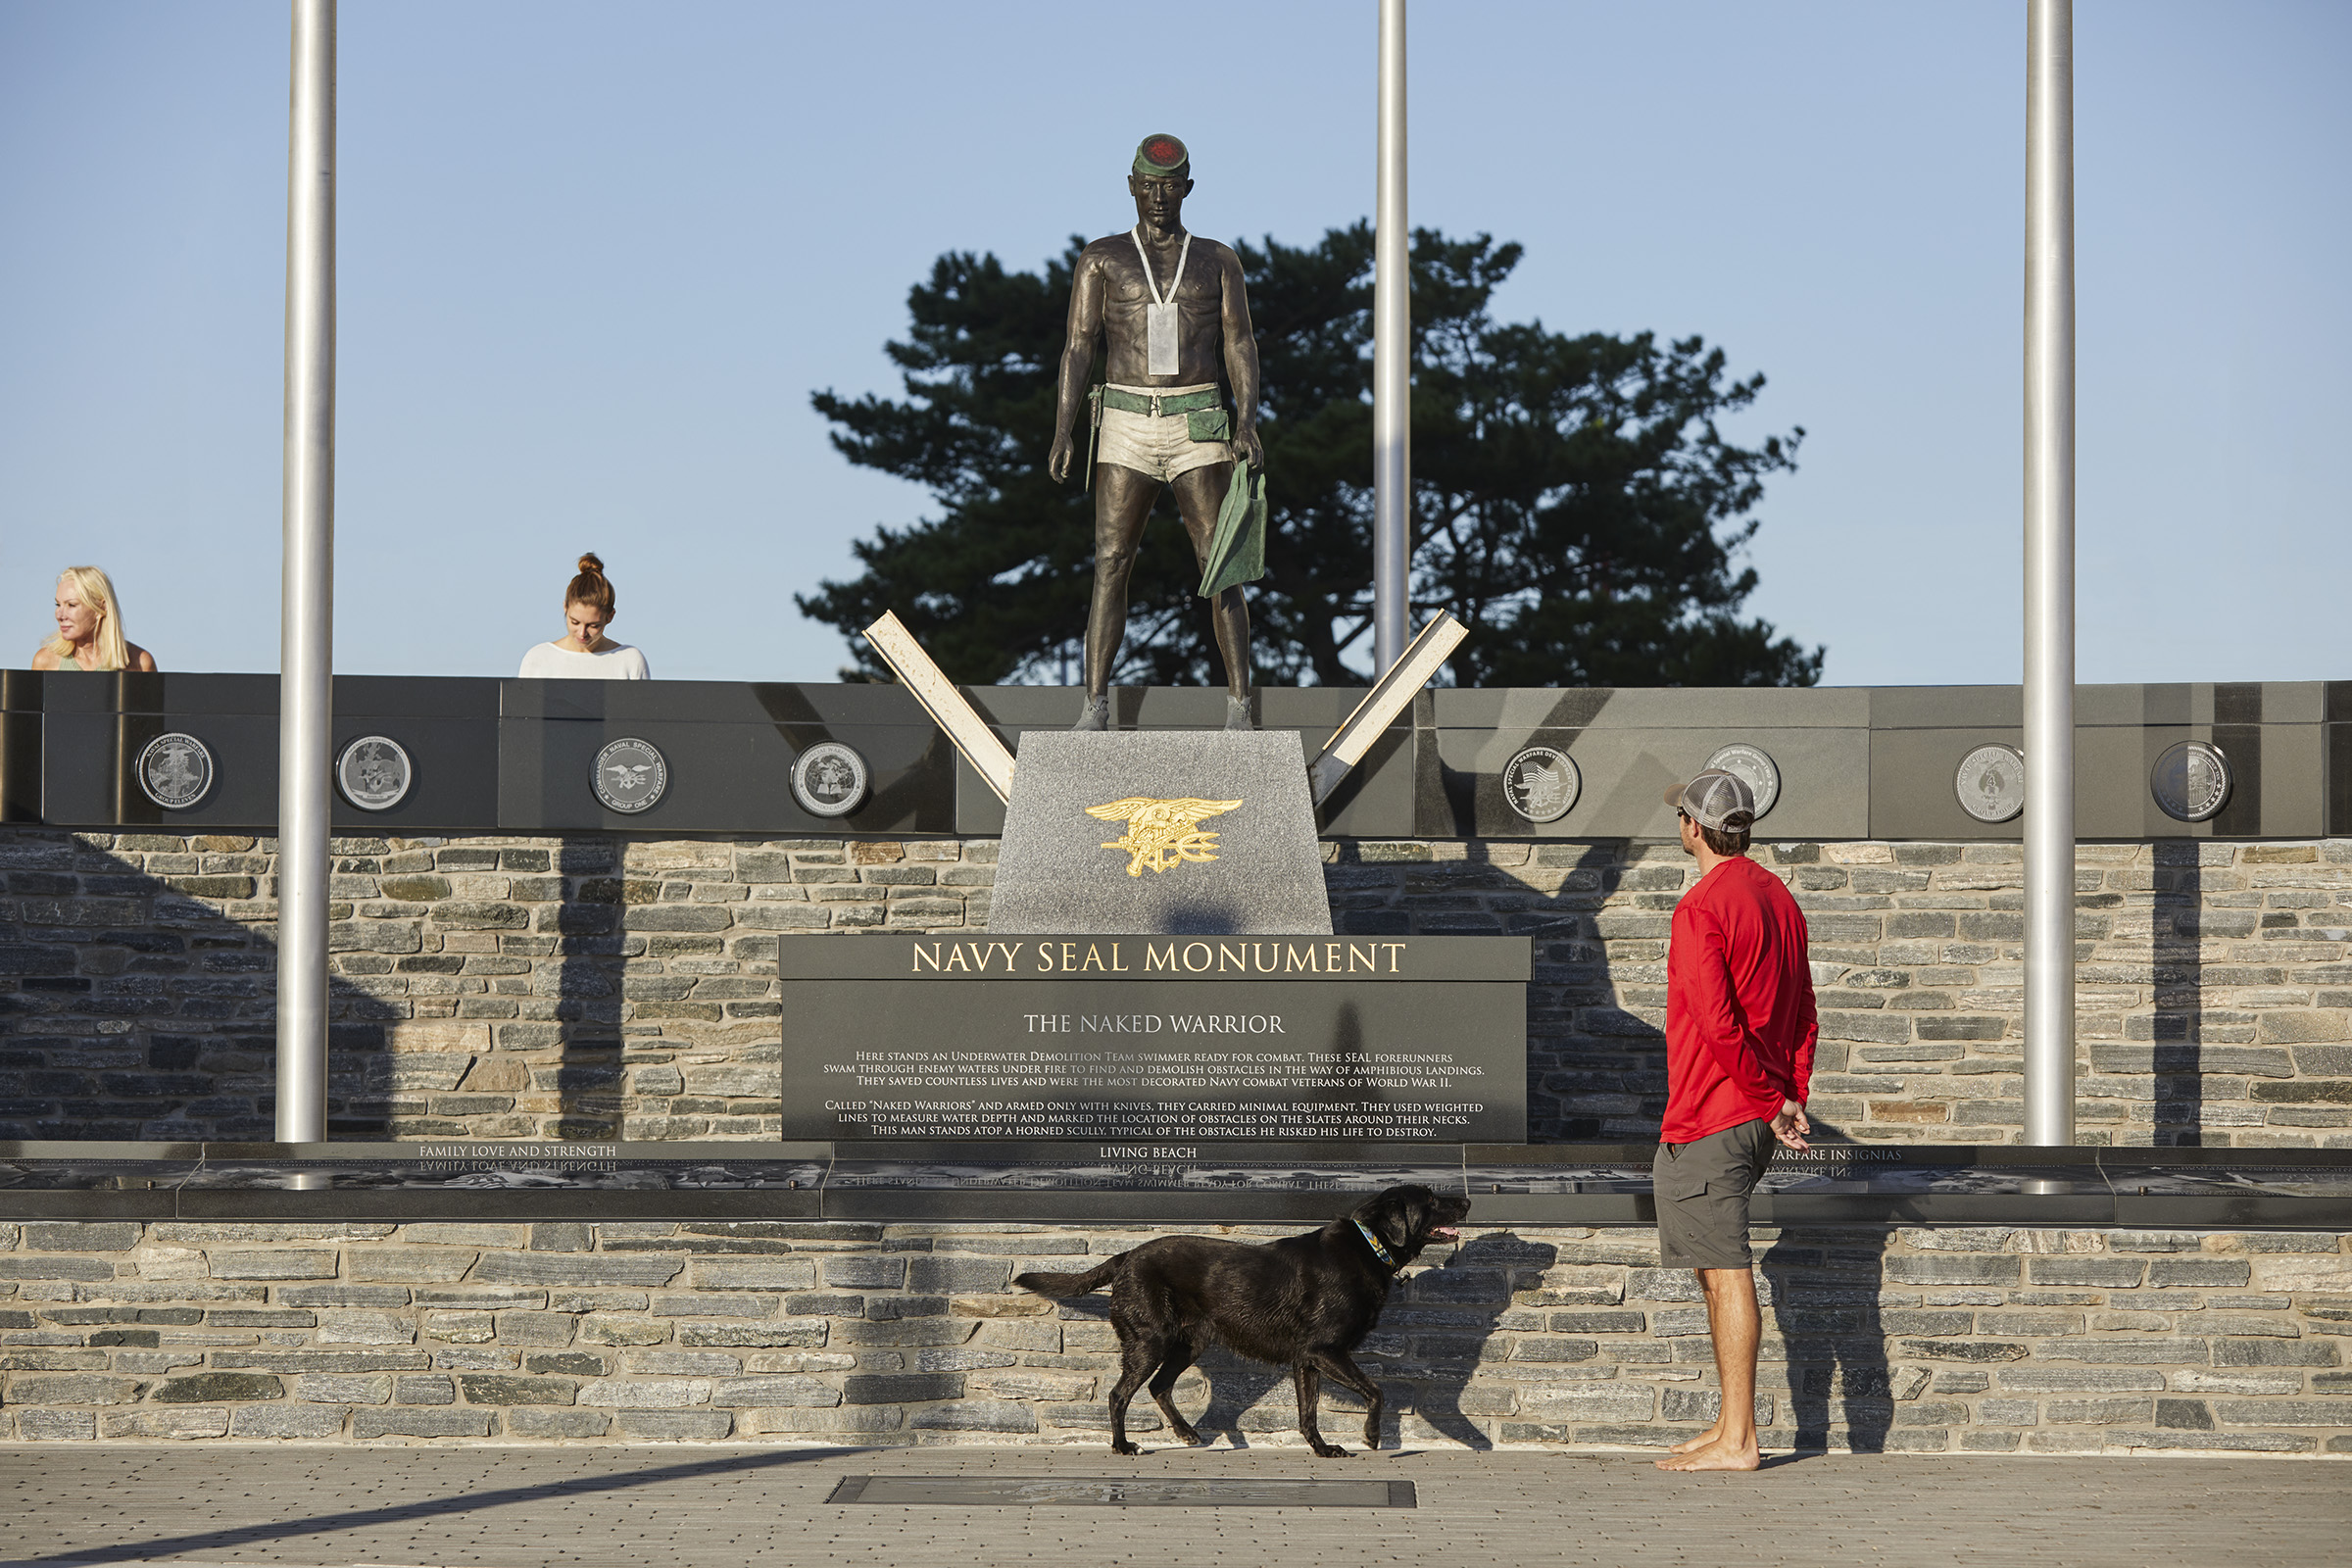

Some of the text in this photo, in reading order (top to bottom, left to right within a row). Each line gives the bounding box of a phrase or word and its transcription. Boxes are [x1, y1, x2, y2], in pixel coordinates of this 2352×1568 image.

[1518, 751, 1544, 763] WARFARE
[1713, 750, 1732, 765] Special
[596, 742, 664, 795] COMMANDER NAVAL SPECIAL WARFARE
[1507, 762, 1519, 786] SPECIAL
[1986, 775, 1996, 788] 4
[1507, 786, 1519, 805] NAVAL
[612, 799, 648, 809] GROUP ONE
[911, 942, 1406, 973] NAVY SEAL MONUMENT
[1023, 1014, 1287, 1034] THE NAKED WARRIOR
[857, 1052, 884, 1061] HERE
[888, 1052, 928, 1061] STANDS
[932, 1052, 947, 1062] AN
[952, 1052, 1027, 1062] UNDERWATER
[1031, 1052, 1101, 1062] DEMOLITION
[1104, 1053, 1134, 1062] TEAM
[1139, 1053, 1191, 1062] SWIMMER
[1195, 1053, 1228, 1062] READY
[1233, 1053, 1253, 1062] FOR
[1308, 1053, 1342, 1063] THESE
[1346, 1053, 1371, 1063] SEAL
[1376, 1053, 1452, 1063] FORERUNNERS
[824, 1063, 855, 1074] SWAM
[858, 1064, 913, 1074] THROUGH
[919, 1064, 955, 1074] ENEMY
[957, 1064, 999, 1074] WATERS
[1003, 1064, 1042, 1074] UNDER
[1045, 1064, 1066, 1074] FIRE
[1070, 1064, 1085, 1075] TO
[1090, 1064, 1116, 1075] FIND
[1119, 1065, 1144, 1075] AND
[1149, 1065, 1203, 1075] DEMOLISH
[1207, 1065, 1265, 1075] OBSTACLES
[1270, 1065, 1281, 1075] IN
[1285, 1065, 1306, 1075] THE
[1310, 1065, 1333, 1076] WAY
[1336, 1065, 1349, 1076] OF
[1353, 1066, 1421, 1076] AMPHIBIOUS
[857, 1076, 886, 1086] THEY
[889, 1076, 922, 1087] SAVED
[925, 1076, 987, 1087] COUNTLESS
[992, 1076, 1018, 1087] LIVES
[1022, 1076, 1047, 1087] AND
[1050, 1076, 1078, 1087] WERE
[1082, 1076, 1103, 1087] THE
[1107, 1076, 1138, 1087] MOST
[1142, 1077, 1206, 1087] DECORATED
[1210, 1077, 1240, 1088] NAVY
[1243, 1077, 1289, 1088] COMBAT
[1292, 1077, 1345, 1088] VETERANS
[1348, 1077, 1362, 1088] OF
[1366, 1077, 1407, 1088] WORLD
[1411, 1077, 1437, 1088] WAR
[825, 1101, 866, 1111] CALLED
[978, 1102, 1003, 1111] AND
[1005, 1102, 1044, 1111] ARMED
[1048, 1102, 1076, 1111] ONLY
[1080, 1102, 1108, 1111] WITH
[1157, 1102, 1186, 1112] THEY
[1189, 1102, 1236, 1112] CARRIED
[1239, 1102, 1289, 1112] MINIMAL
[1361, 1102, 1391, 1112] THEY
[1394, 1102, 1421, 1112] USED
[1425, 1102, 1483, 1112] WEIGHTED
[839, 1113, 867, 1123] LINES
[871, 1113, 886, 1123] TO
[891, 1113, 938, 1123] MEASURE
[942, 1114, 978, 1124] WATER
[982, 1114, 1016, 1124] DEPTH
[1020, 1114, 1045, 1124] AND
[1049, 1114, 1093, 1124] MARKED
[1097, 1114, 1118, 1124] THE
[1123, 1114, 1177, 1124] LOCATION
[1182, 1114, 1196, 1124] OF
[1200, 1114, 1256, 1124] OBSTACLES
[1260, 1114, 1277, 1124] ON
[1281, 1115, 1302, 1125] THE
[1306, 1115, 1342, 1125] SLATES
[1345, 1115, 1393, 1125] AROUND
[1396, 1115, 1430, 1125] THEIR
[871, 1125, 897, 1136] THIS
[901, 1125, 925, 1136] MAN
[930, 1125, 970, 1136] STANDS
[974, 1125, 1002, 1136] ATOP
[1005, 1126, 1012, 1136] A
[1016, 1126, 1063, 1136] HORNED
[1110, 1126, 1152, 1136] TYPICAL
[1156, 1126, 1170, 1137] OF
[1174, 1126, 1195, 1137] THE
[1199, 1126, 1256, 1137] OBSTACLES
[1261, 1126, 1274, 1137] HE
[1279, 1126, 1316, 1137] RISKED
[1321, 1127, 1339, 1137] HIS
[1343, 1127, 1363, 1137] LIFE
[1367, 1127, 1382, 1137] TO
[419, 1145, 616, 1157] FAMILY LOVE AND STRENGTH
[1100, 1147, 1197, 1158] LIVING BEACH
[1831, 1150, 1902, 1160] INSIGNIAS
